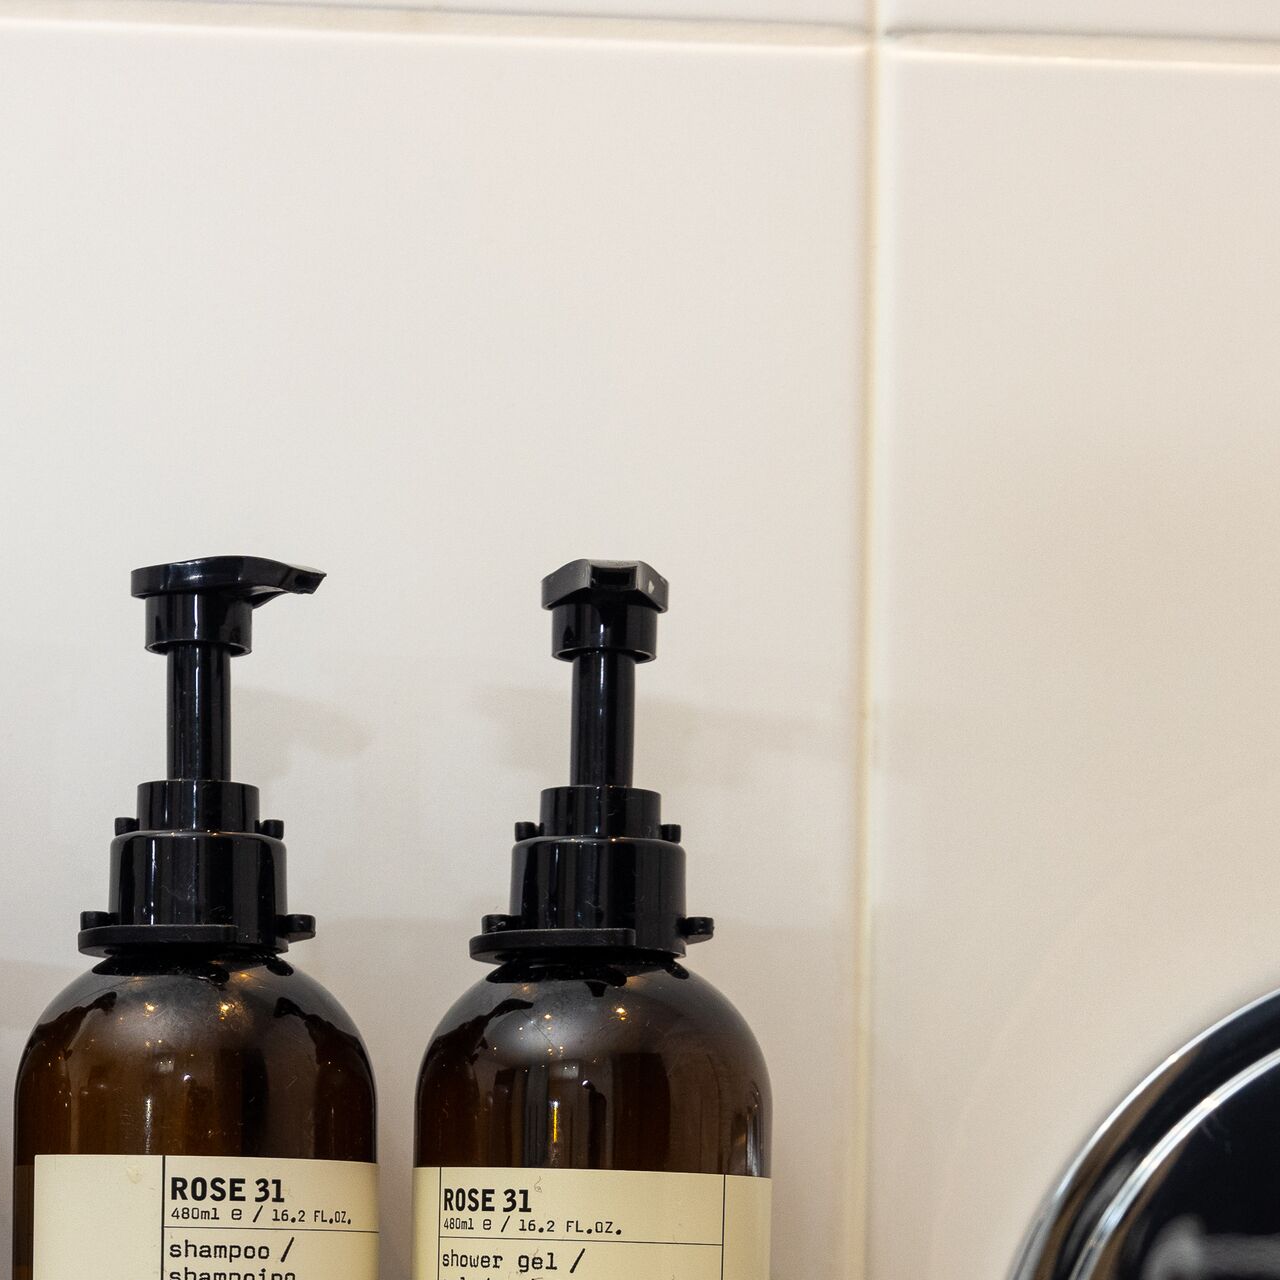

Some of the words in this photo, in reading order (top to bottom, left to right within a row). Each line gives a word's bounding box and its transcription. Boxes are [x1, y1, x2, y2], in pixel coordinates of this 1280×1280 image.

[171, 1177, 246, 1202] ROSE
[255, 1178, 285, 1203] 31
[444, 1188, 495, 1212] ROSE
[503, 1189, 532, 1213] 31
[171, 1207, 220, 1220] 480ml
[252, 1205, 263, 1223] /
[272, 1209, 305, 1223] 16.2
[314, 1210, 351, 1224] FL.OZ.
[444, 1217, 474, 1230] 480ml
[501, 1215, 510, 1233] /
[519, 1219, 555, 1233] 16.2
[566, 1220, 622, 1235] FL.OZ.
[169, 1239, 270, 1263] shampoo
[280, 1237, 295, 1263] /
[442, 1249, 503, 1269] shower
[516, 1252, 558, 1276] gel
[569, 1248, 586, 1273] /
